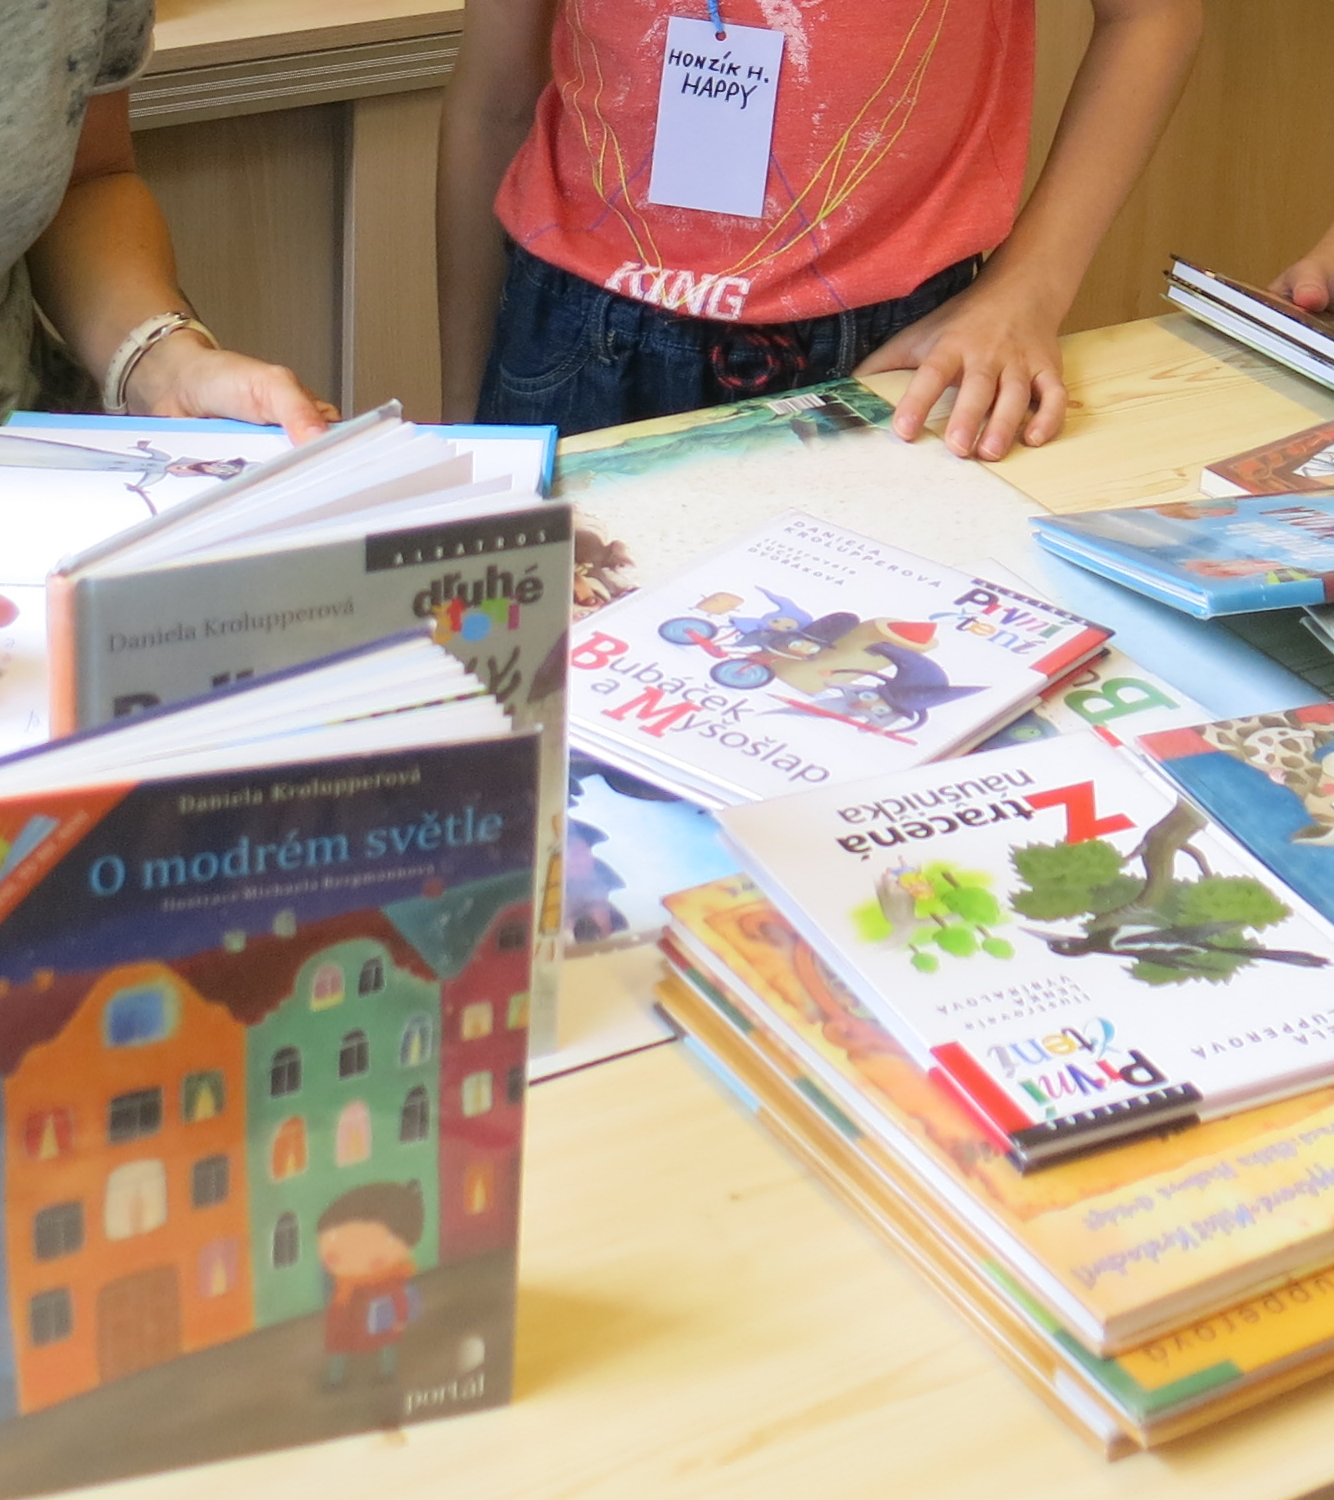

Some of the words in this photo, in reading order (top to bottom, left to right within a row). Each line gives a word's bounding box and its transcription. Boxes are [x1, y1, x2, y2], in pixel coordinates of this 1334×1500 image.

[668, 50, 740, 77] HONZÍK
[747, 65, 770, 84] H.
[681, 74, 757, 109] HAPPY
[604, 261, 751, 321] KING
[394, 531, 548, 565] ALBATROS
[412, 564, 544, 619] druhé
[108, 626, 197, 654] Daniela
[204, 597, 356, 638] Krolupperová
[570, 631, 754, 723] Bubáček
[591, 678, 620, 695] a
[601, 686, 830, 783] Myšošlap
[179, 787, 264, 815] Daniela
[272, 765, 422, 803] Krolupperová
[838, 768, 1037, 827] náušnička
[88, 854, 126, 896] O
[142, 828, 351, 890] modrém
[366, 806, 504, 858] světle
